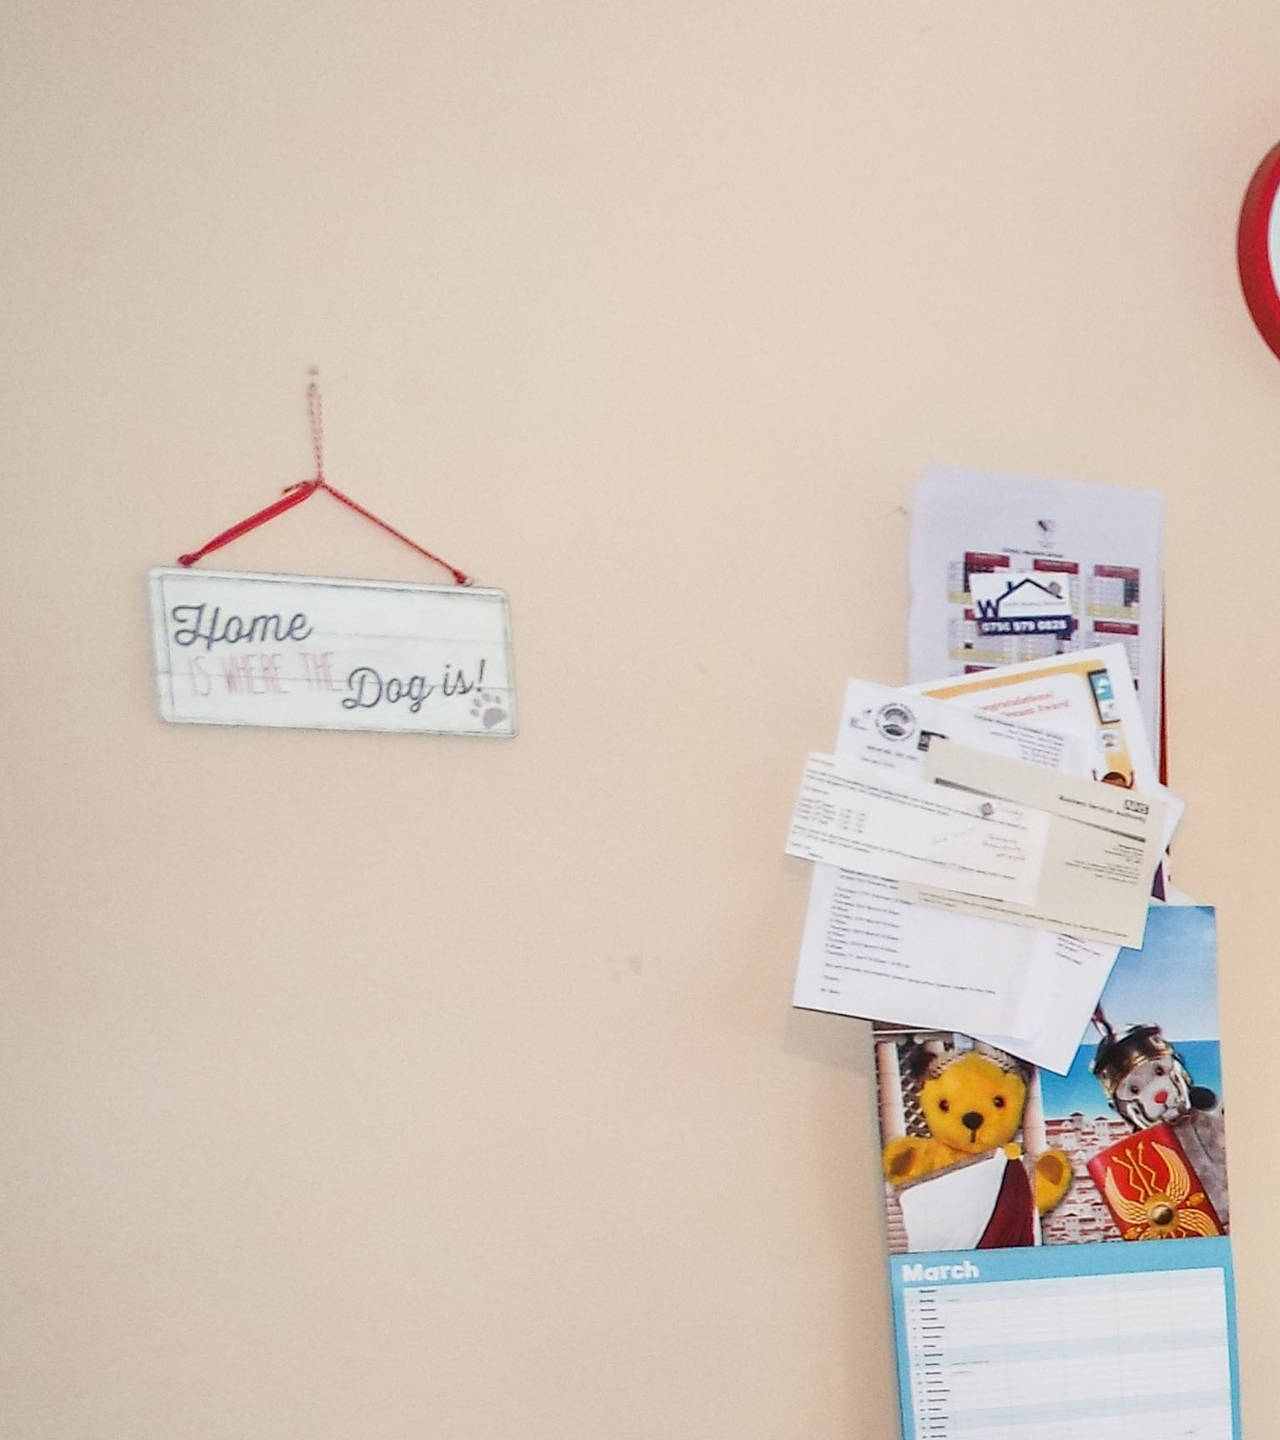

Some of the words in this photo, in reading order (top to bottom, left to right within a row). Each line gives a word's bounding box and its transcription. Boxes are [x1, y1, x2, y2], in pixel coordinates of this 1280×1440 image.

[172, 603, 314, 651] Home
[189, 655, 212, 697] IS
[222, 653, 291, 695] WHERE
[299, 651, 344, 693] THE
[342, 667, 434, 713] Dog
[443, 658, 485, 697] is!
[902, 1260, 979, 1281] March
